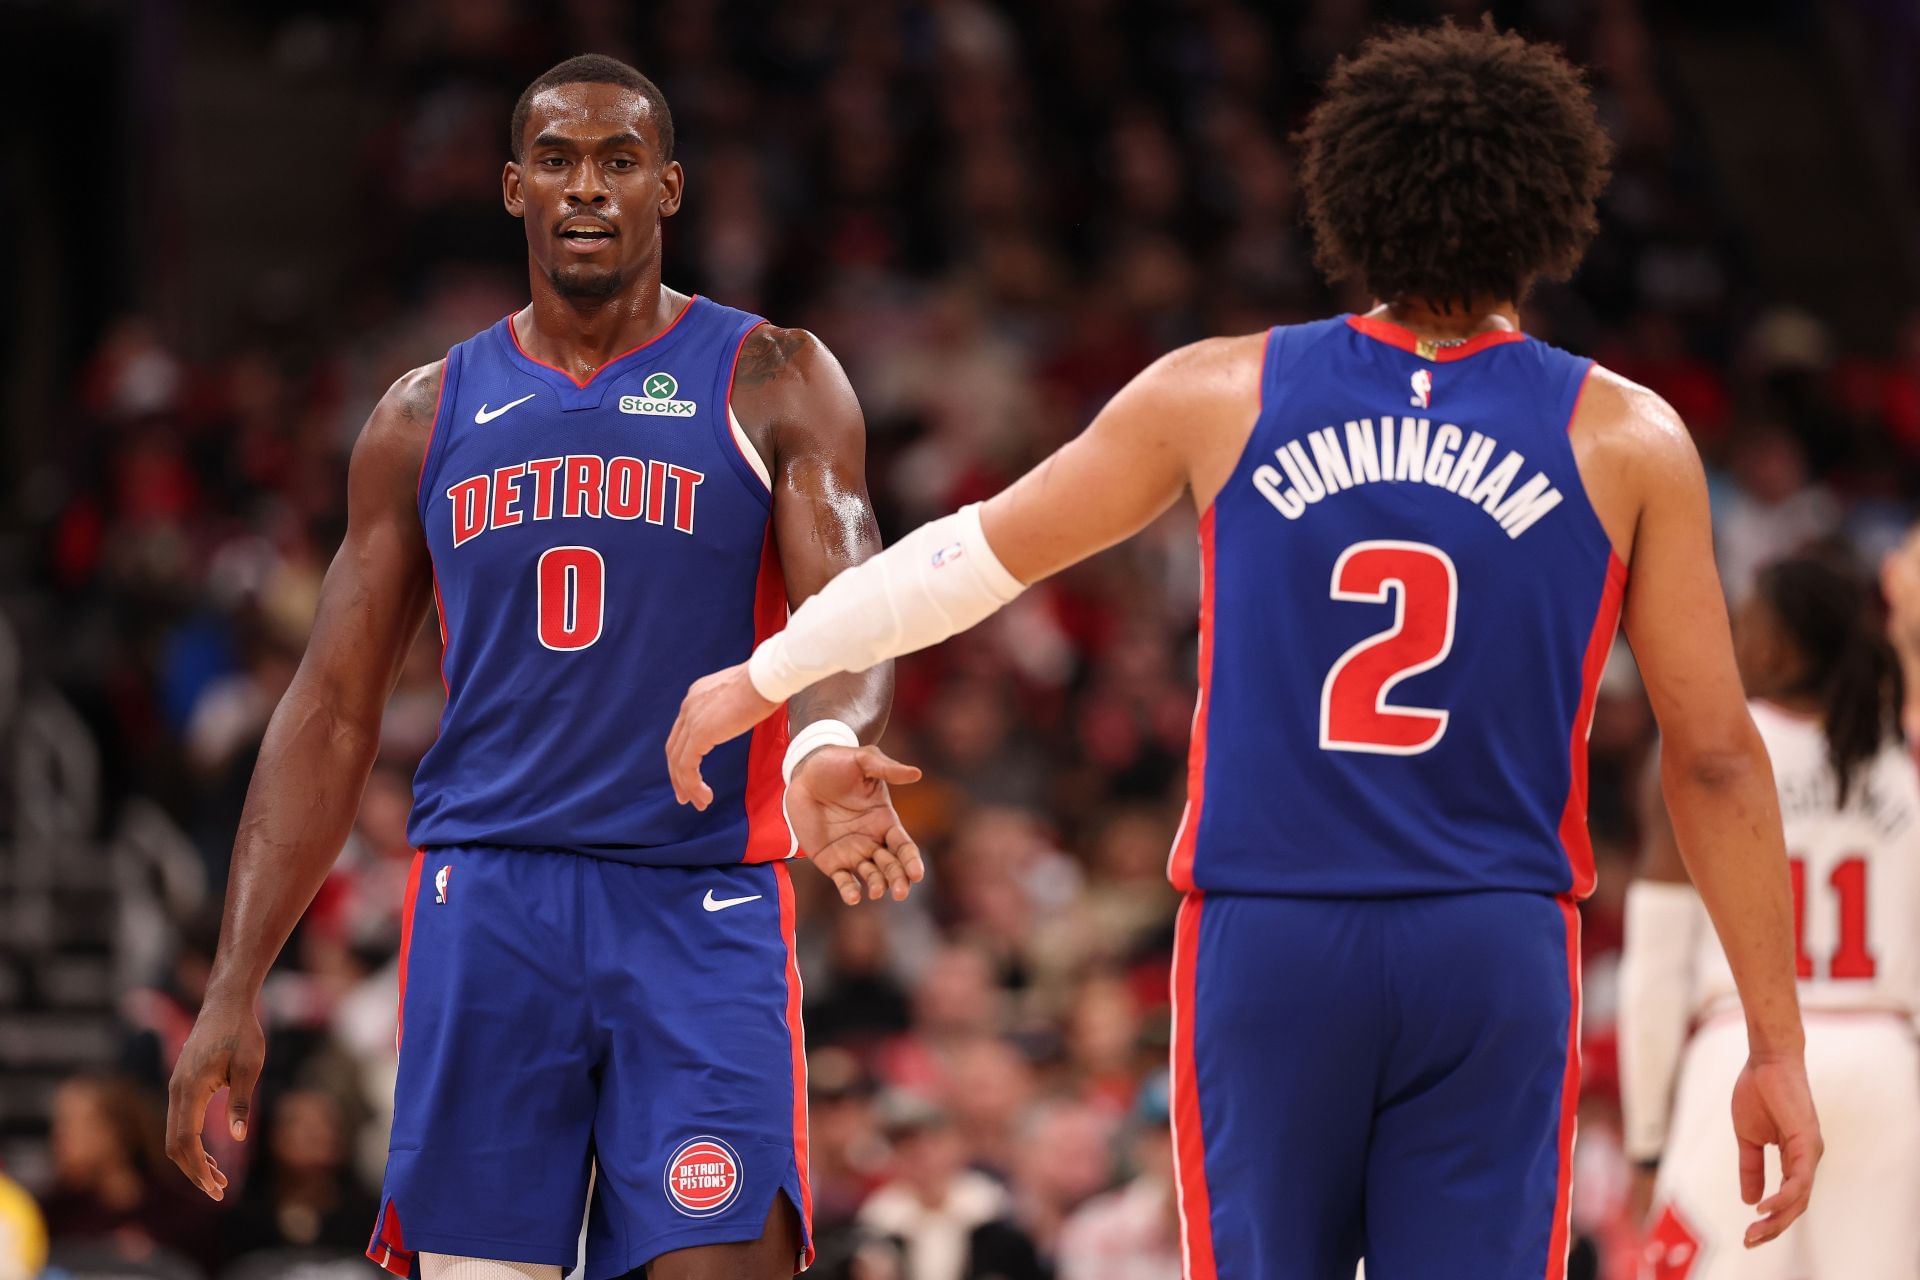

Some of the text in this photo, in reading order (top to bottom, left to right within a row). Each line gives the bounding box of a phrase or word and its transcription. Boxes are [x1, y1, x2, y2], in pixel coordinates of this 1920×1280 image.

[622, 398, 693, 414] StockX
[446, 455, 705, 549] DETROIT
[1252, 416, 1564, 539] CUNNINGHAM
[537, 545, 605, 651] 0
[1319, 540, 1458, 756] 2
[679, 1162, 726, 1178] DETROIT
[679, 1175, 727, 1190] PISTONS
